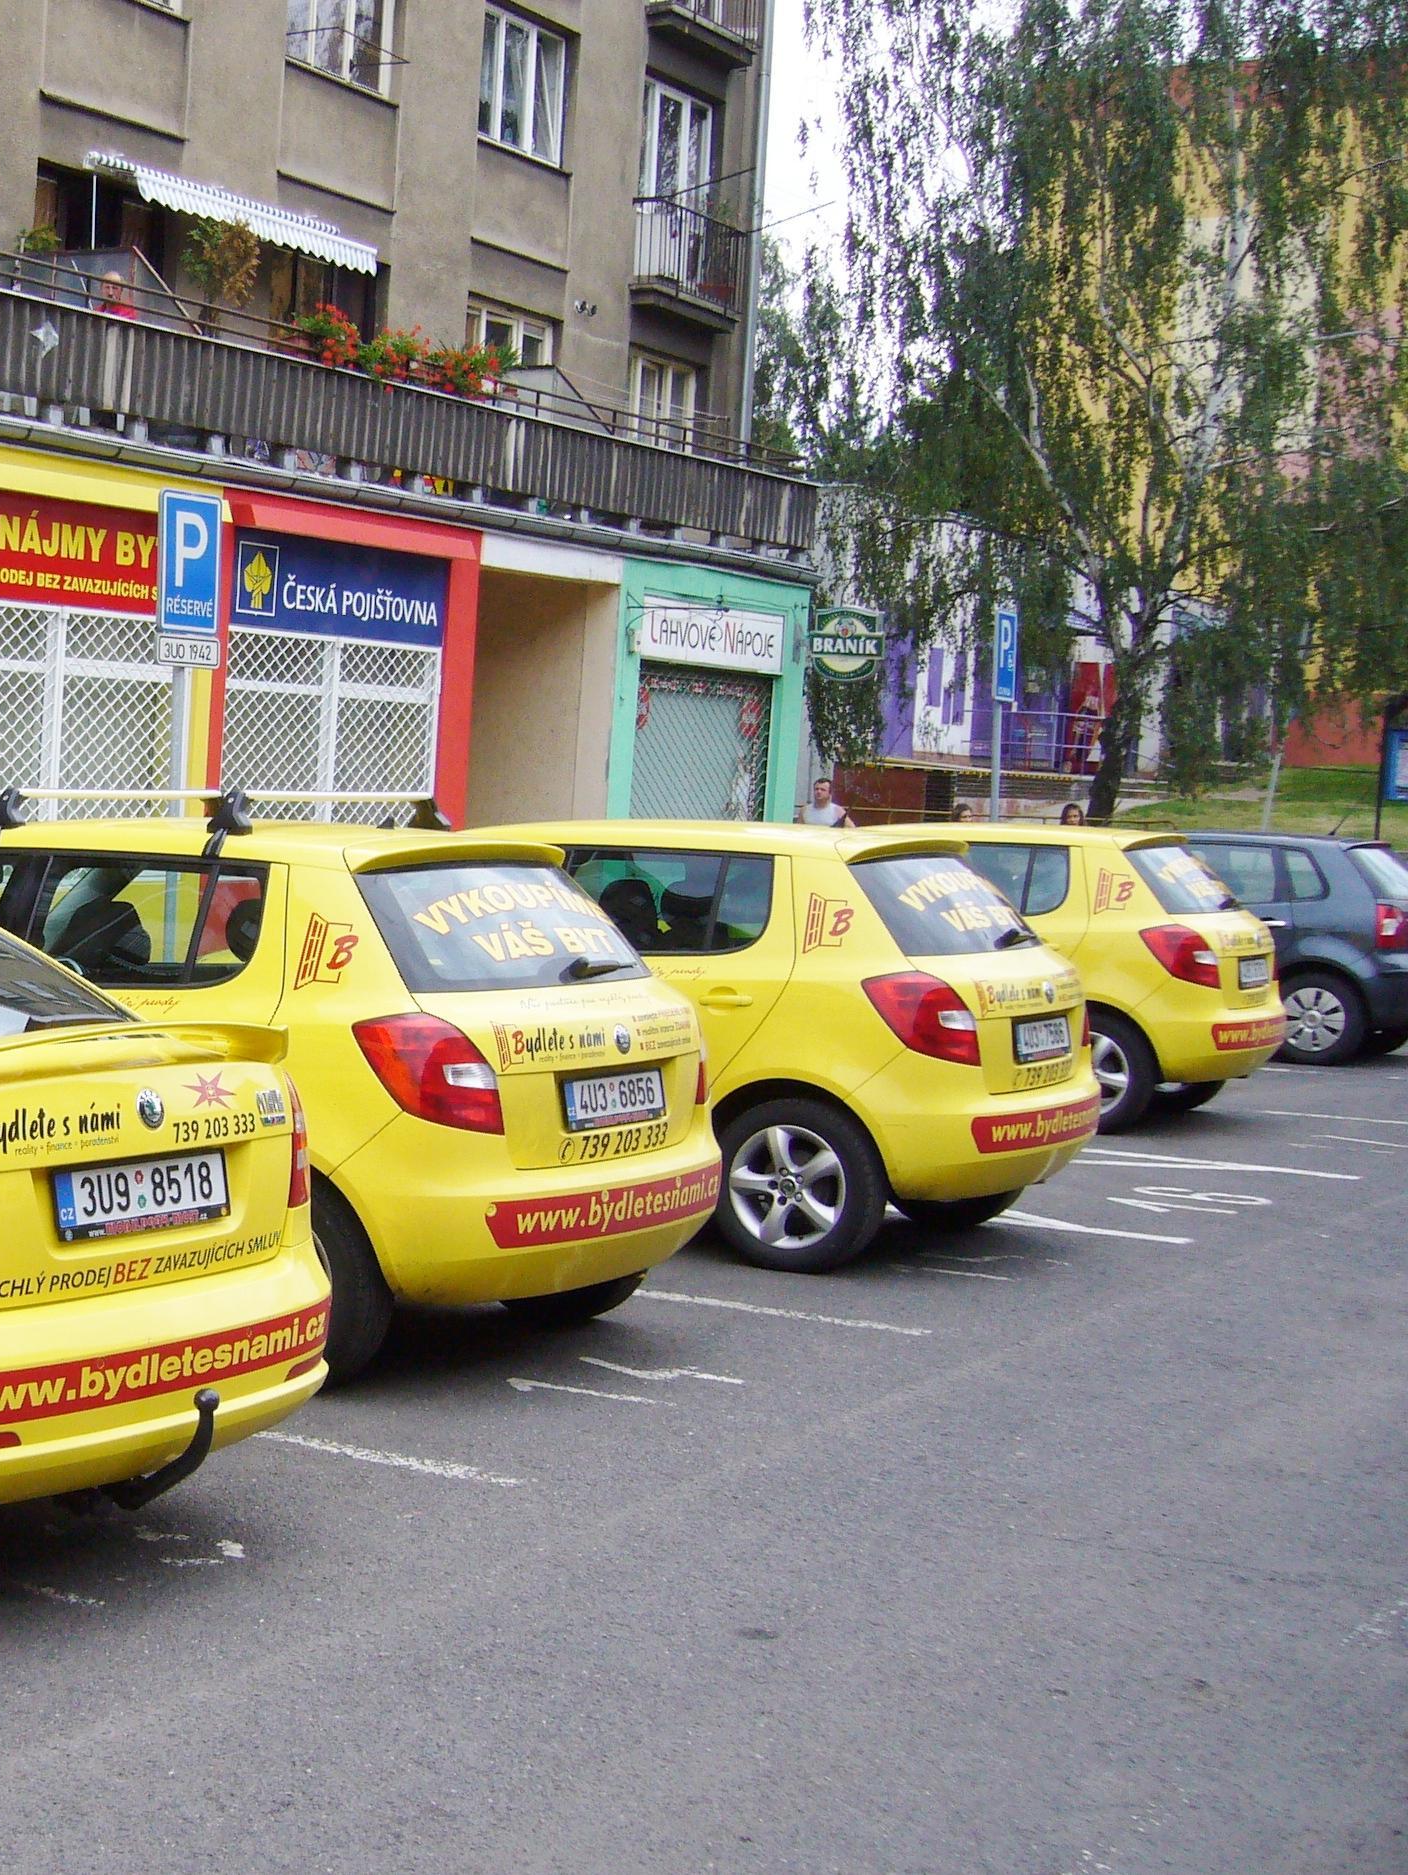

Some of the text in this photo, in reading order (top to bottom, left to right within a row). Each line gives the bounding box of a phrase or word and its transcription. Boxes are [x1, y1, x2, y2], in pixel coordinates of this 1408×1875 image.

[115, 531, 158, 569] BY
[174, 510, 209, 588] P
[36, 572, 61, 590] BEZ
[63, 574, 149, 600] ZAVAZUJÍCÍCH
[282, 573, 438, 627] ČESKÁ POJIŠŤOVNA
[165, 595, 214, 618] RÉSERVÉ
[189, 642, 212, 662] 1942
[812, 636, 878, 655] BRANÍK
[999, 618, 1012, 669] P
[1115, 880, 1136, 902] B
[471, 920, 615, 963] VÁŠ BYT
[828, 908, 855, 937] B
[326, 934, 359, 970] B
[511, 1024, 606, 1062] Bydlete s námi
[580, 1076, 655, 1115] 4U3 6856
[62, 1116, 71, 1136] s
[78, 1102, 121, 1135] námi
[172, 1120, 199, 1144] 739
[204, 1116, 229, 1140] 203
[233, 1113, 256, 1136] 333
[579, 1121, 669, 1160] 739 203 333
[79, 1160, 213, 1218] 3U9 8518
[516, 1173, 720, 1235] www.bydletesnami.cz
[59, 1207, 75, 1222] CZ
[48, 1265, 113, 1293] PRODEJ
[111, 1257, 153, 1285] BEZ
[152, 1239, 245, 1276] ZAVAZUJÍCÍCH
[245, 1229, 282, 1256] SMLUV
